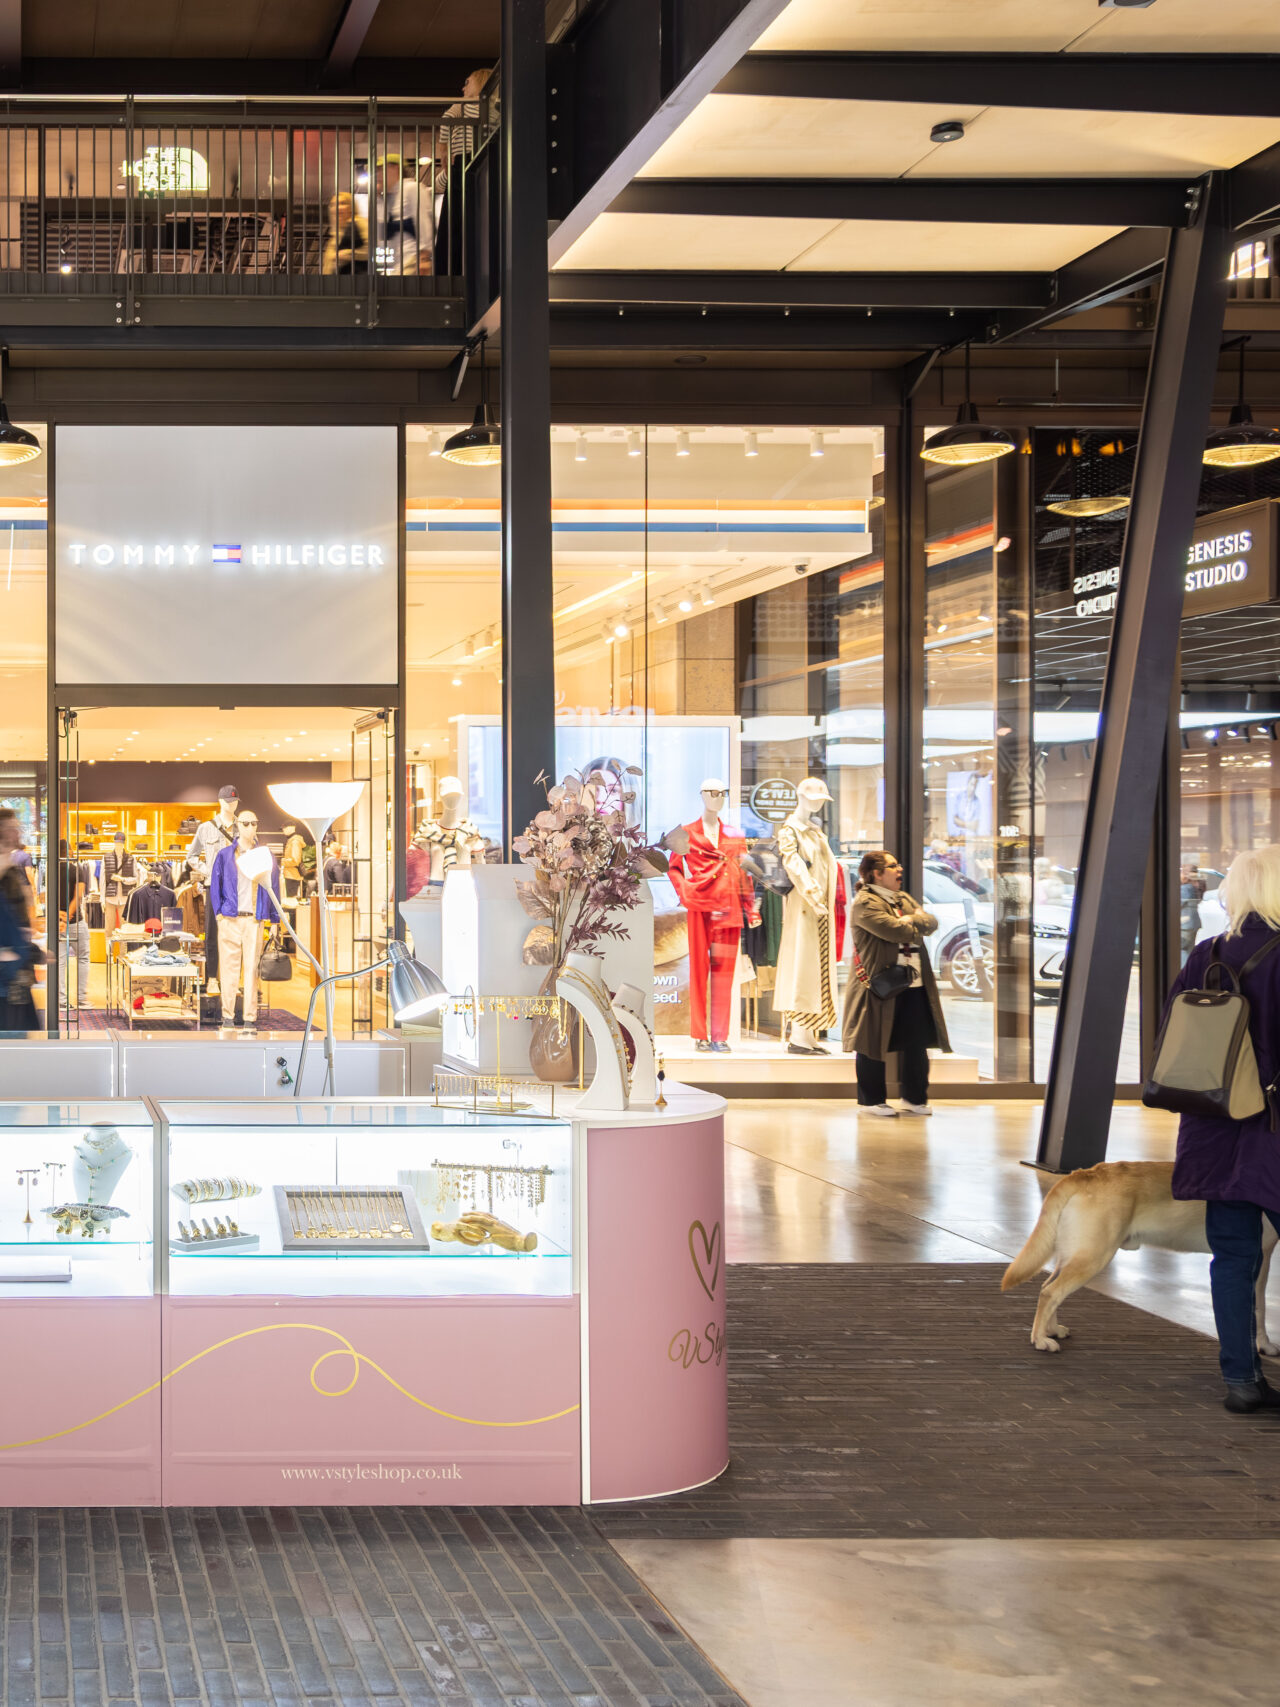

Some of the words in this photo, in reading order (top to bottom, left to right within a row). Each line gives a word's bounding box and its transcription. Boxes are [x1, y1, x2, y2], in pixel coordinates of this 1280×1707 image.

[68, 544, 201, 566] TOMMY
[251, 544, 385, 566] HILFIGER
[1184, 559, 1249, 592] STUDIO
[280, 1463, 463, 1483] www.vstyleshop.co.uk
